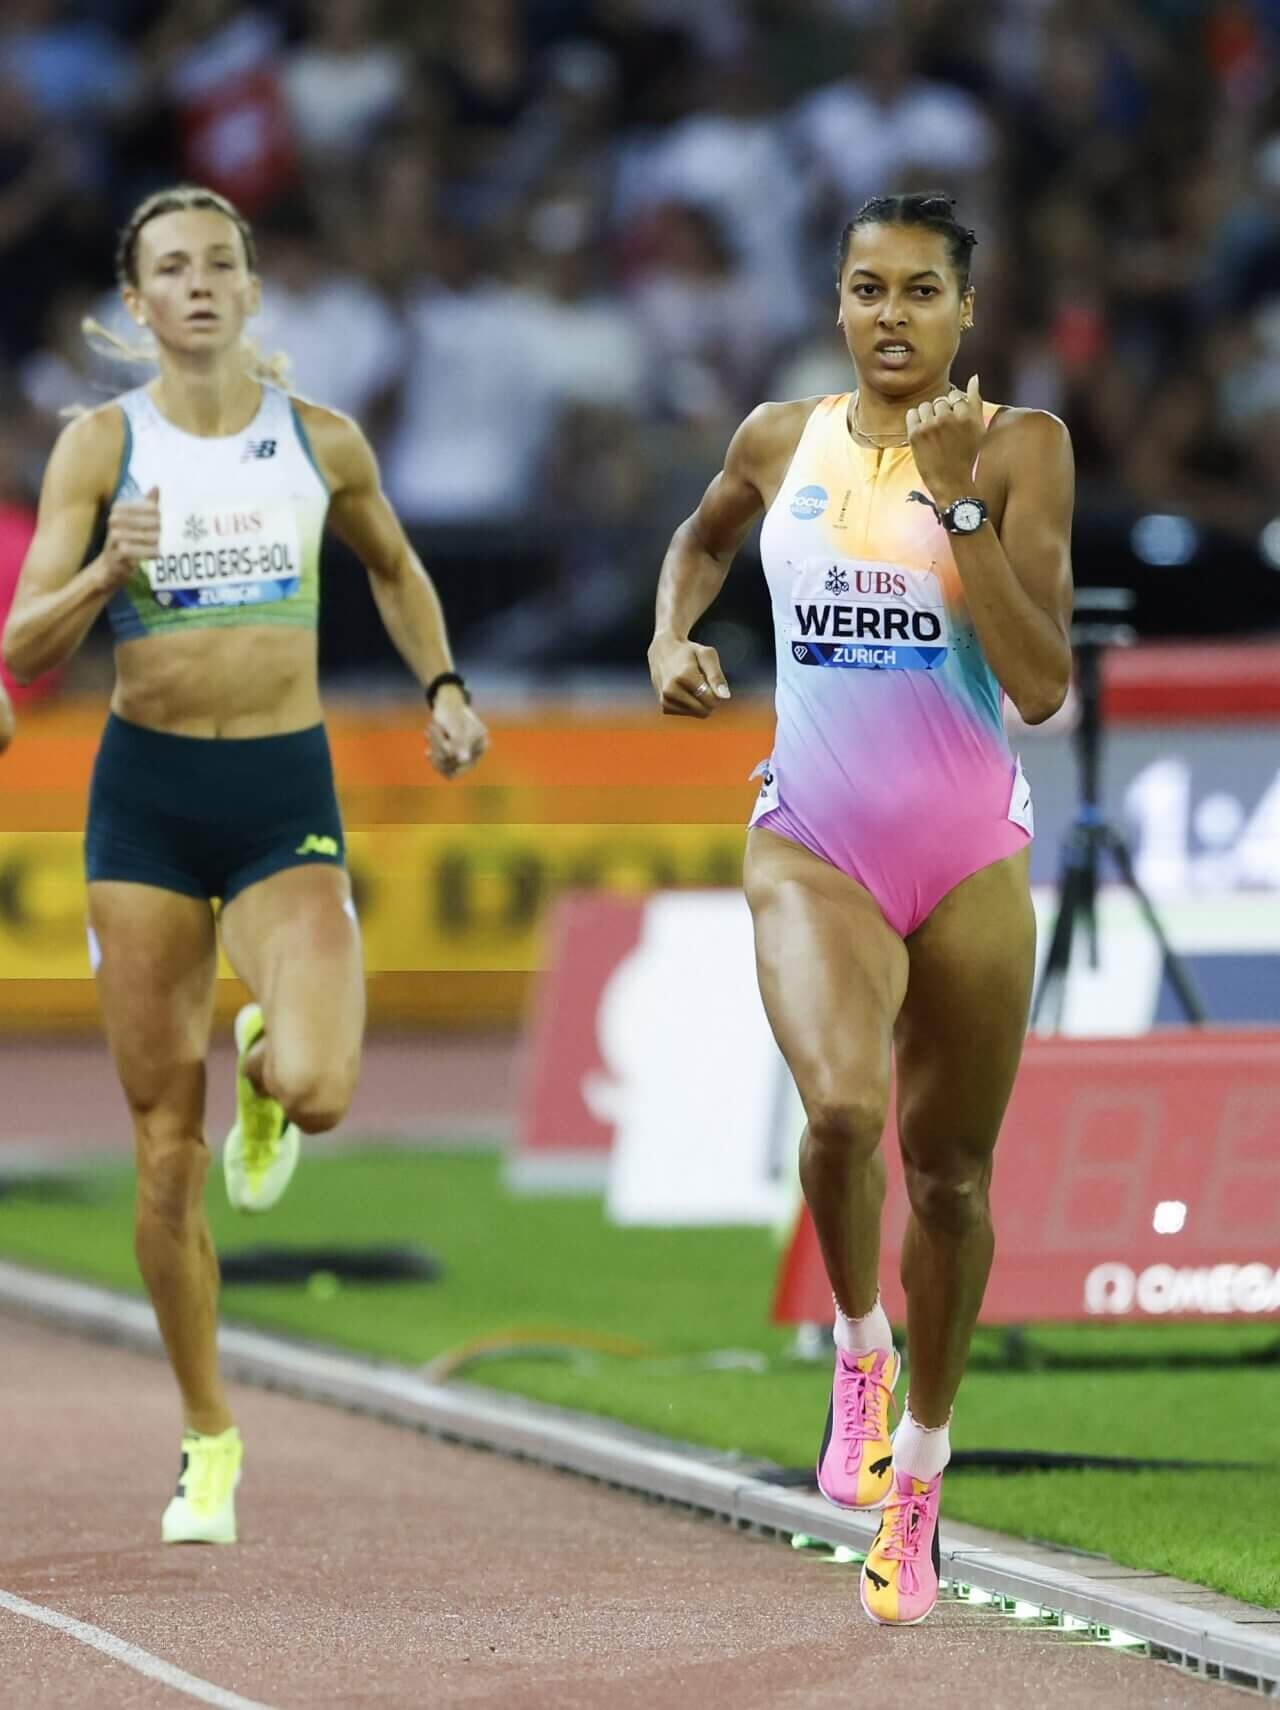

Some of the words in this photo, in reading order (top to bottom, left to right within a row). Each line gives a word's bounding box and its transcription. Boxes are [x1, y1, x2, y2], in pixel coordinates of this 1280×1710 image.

[155, 543, 294, 584] BROEDERS-BOL
[853, 570, 907, 597] UBS
[793, 604, 942, 642] WERRO
[831, 647, 897, 666] ZURICH
[1137, 1262, 1280, 1315] OMEG
